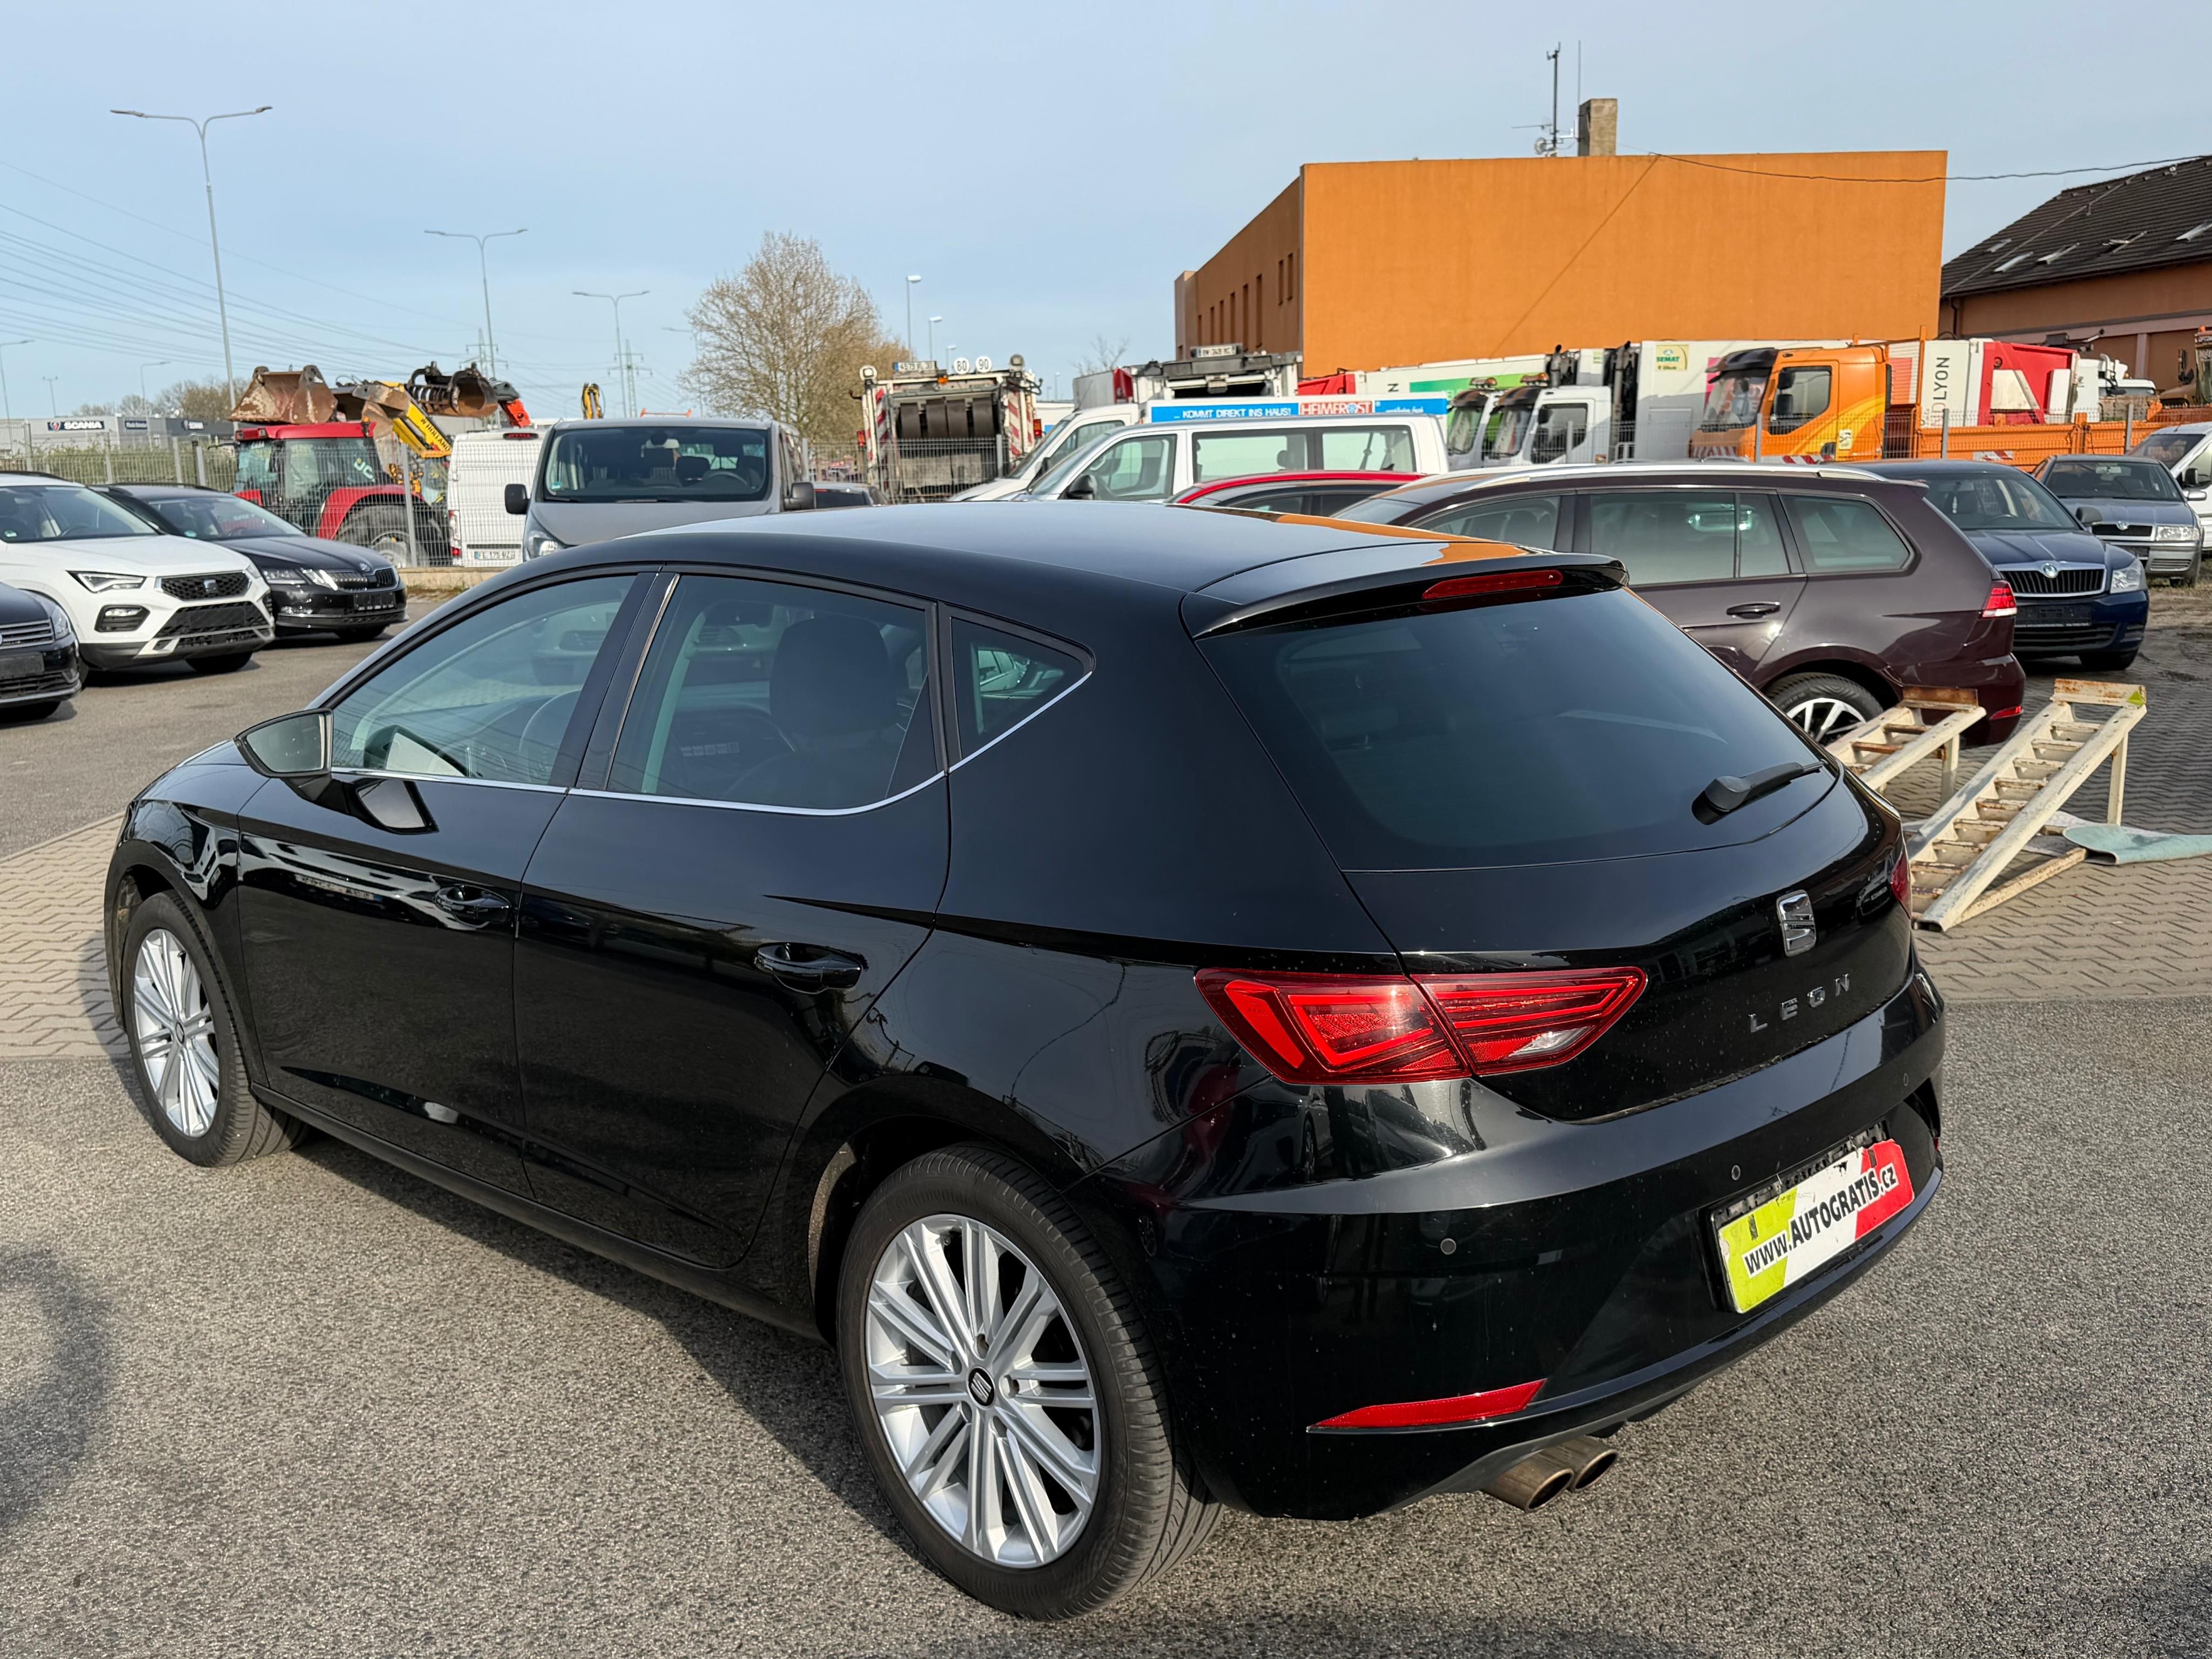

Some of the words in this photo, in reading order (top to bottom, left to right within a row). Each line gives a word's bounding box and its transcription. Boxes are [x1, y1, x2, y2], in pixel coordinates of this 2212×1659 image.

[957, 361, 967, 372] 80
[979, 359, 989, 370] 90
[1183, 409, 1214, 419] KOMMT
[1216, 409, 1246, 418] DIREKT
[1249, 408, 1262, 417] INS
[1265, 408, 1291, 416] HAUS!
[1301, 402, 1371, 415] HEIMFROST
[64, 421, 103, 430] SCANIA
[1749, 973, 1850, 1033] LEON
